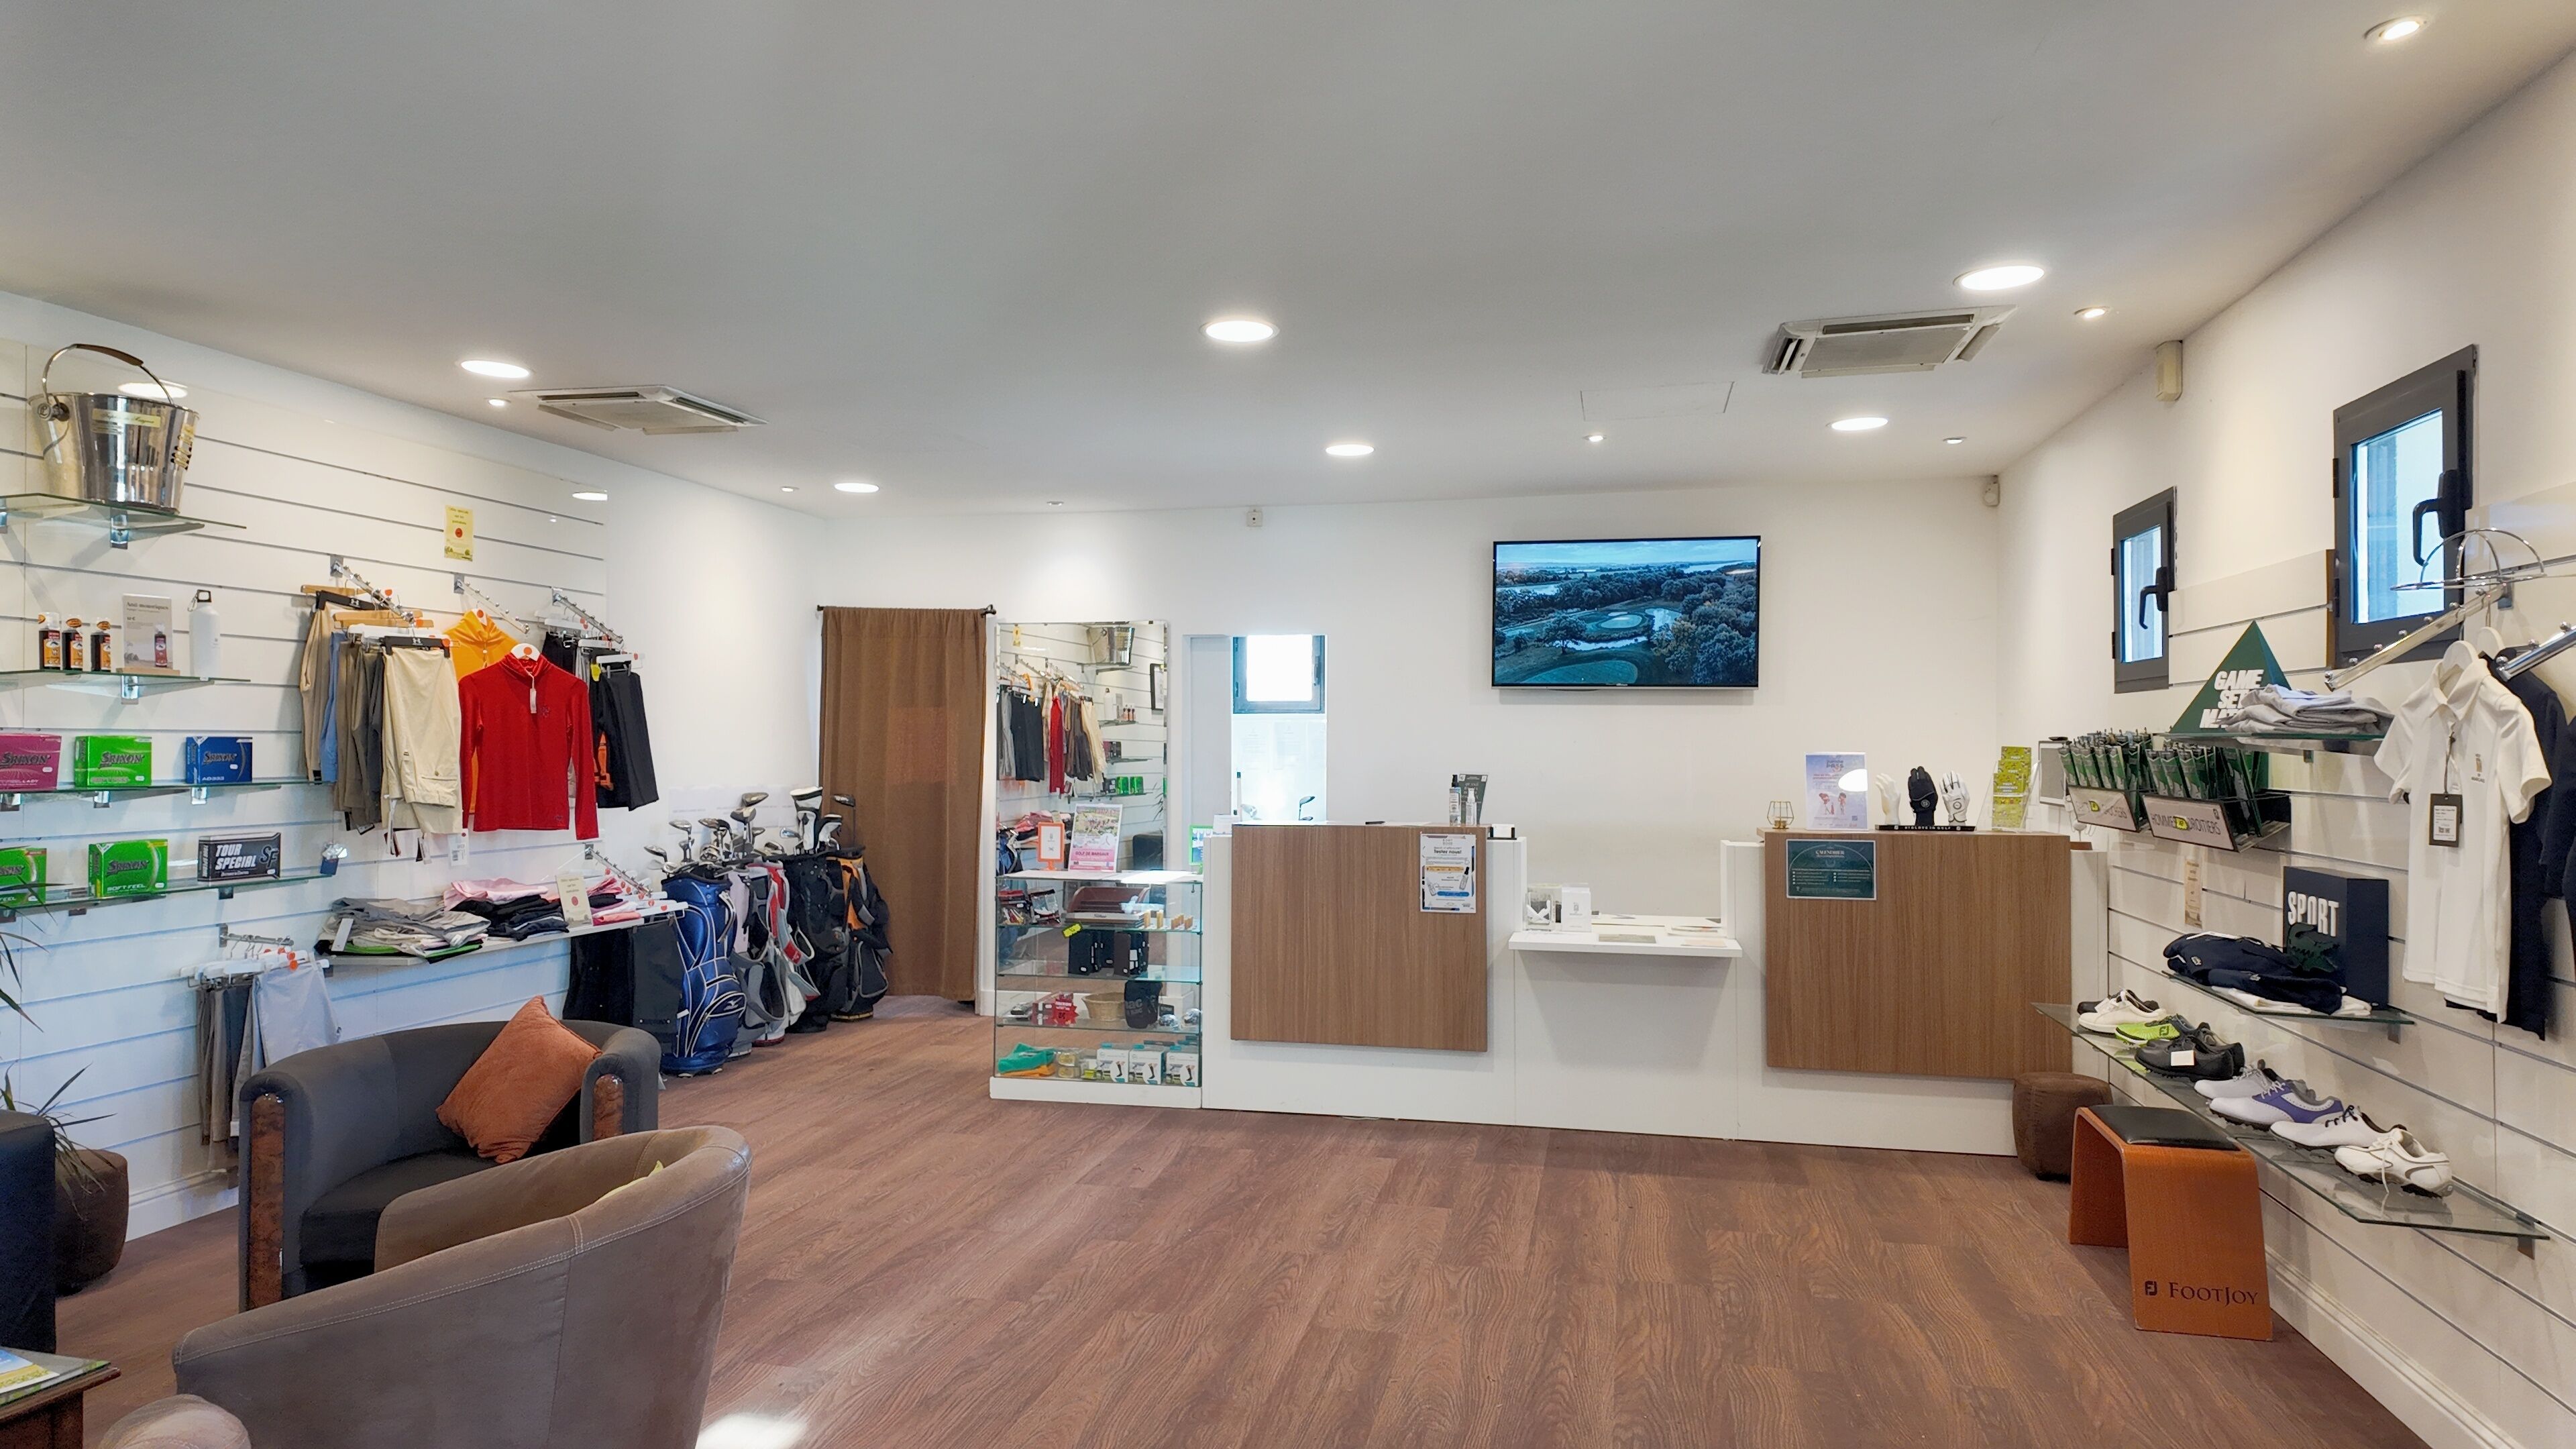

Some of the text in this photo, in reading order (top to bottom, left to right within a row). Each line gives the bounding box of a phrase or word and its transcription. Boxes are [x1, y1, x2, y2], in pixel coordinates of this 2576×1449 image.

[2214, 669, 2265, 690] GAME
[0, 751, 51, 769] SRIXON
[98, 751, 145, 769] SRIXON
[215, 843, 279, 868] TOUR SF
[215, 855, 257, 871] SPECIAL
[106, 860, 150, 877] SRIXON
[2288, 891, 2339, 937] SPORT
